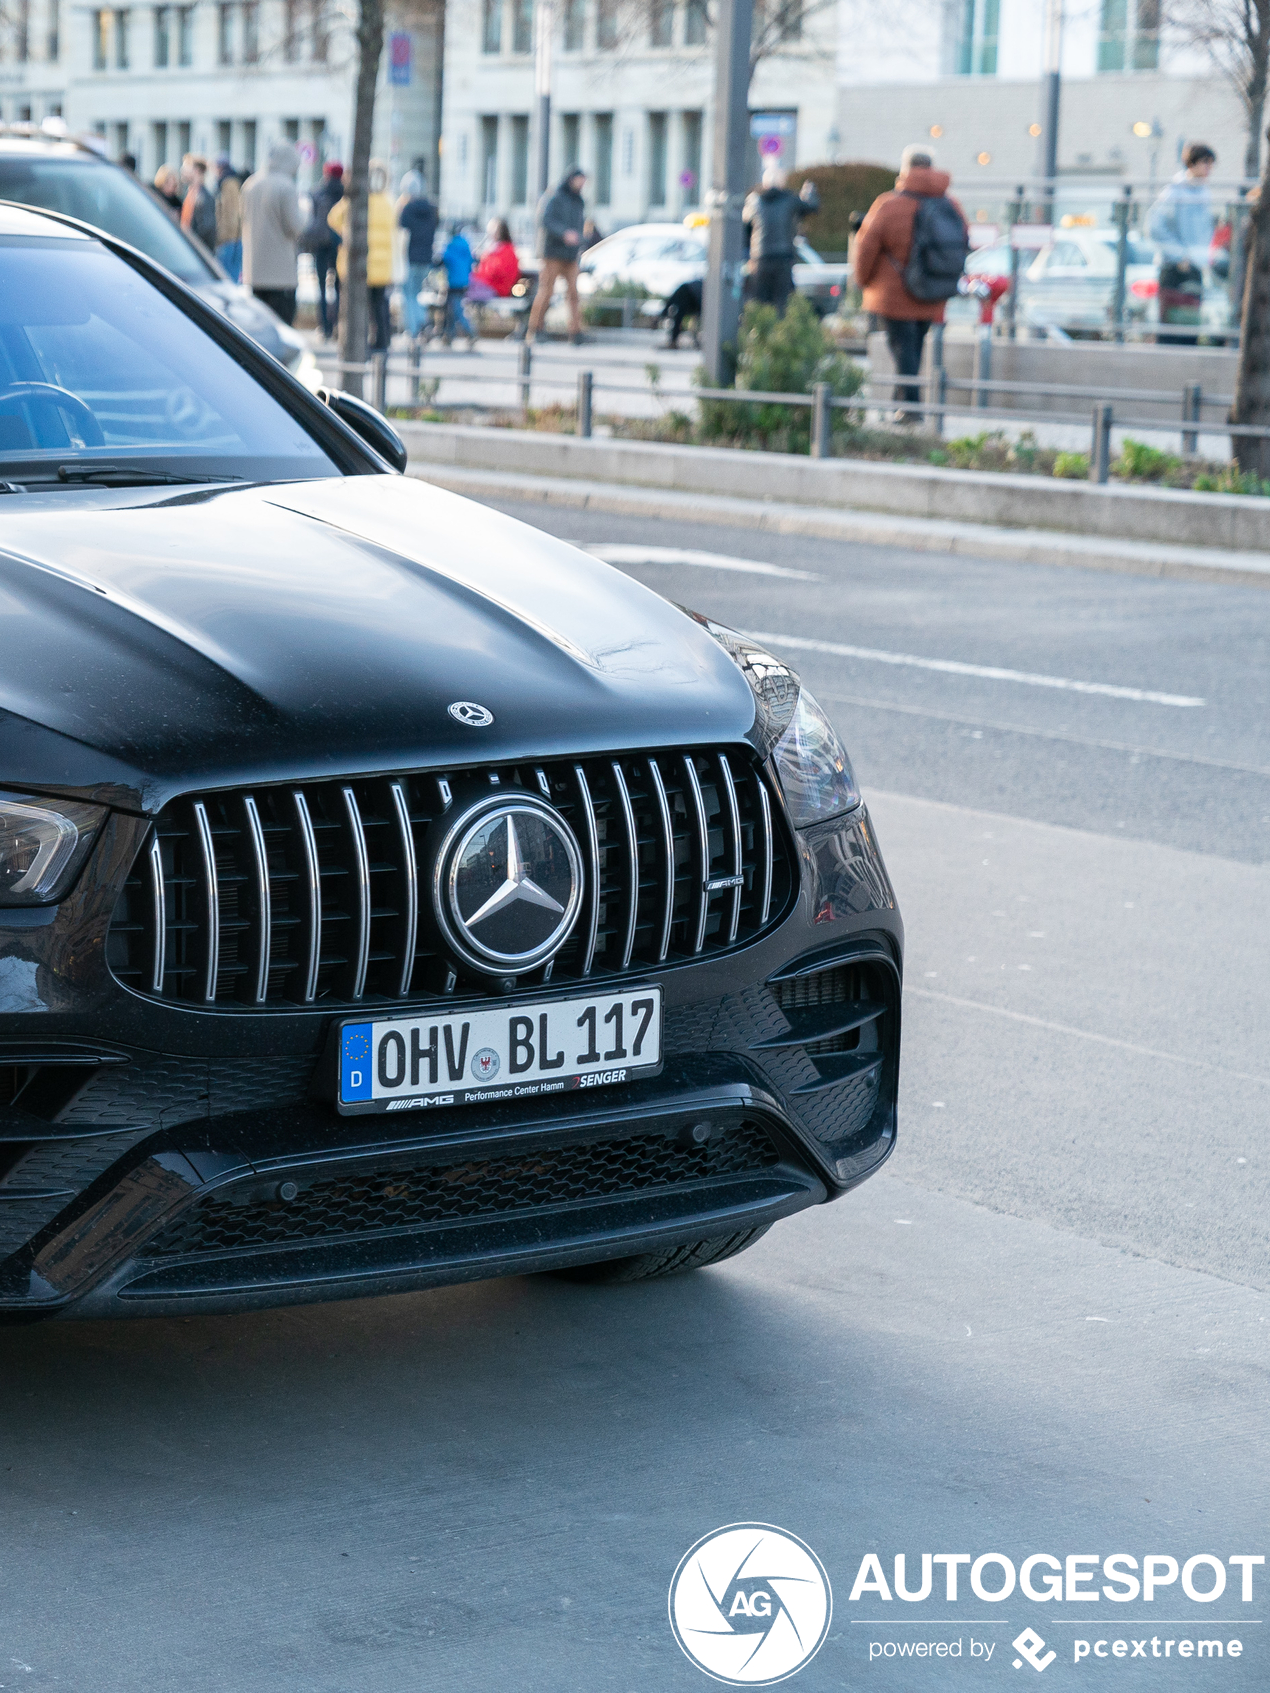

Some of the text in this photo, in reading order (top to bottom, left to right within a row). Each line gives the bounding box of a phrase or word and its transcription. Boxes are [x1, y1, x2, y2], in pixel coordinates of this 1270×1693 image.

[721, 877, 744, 887] AMG
[377, 1021, 470, 1088] OHV
[508, 1013, 565, 1074] BL
[576, 998, 655, 1064] 117
[350, 1070, 363, 1088] D
[579, 1069, 626, 1088] SENGER
[411, 1081, 564, 1107] AMG Performance Center Hamm
